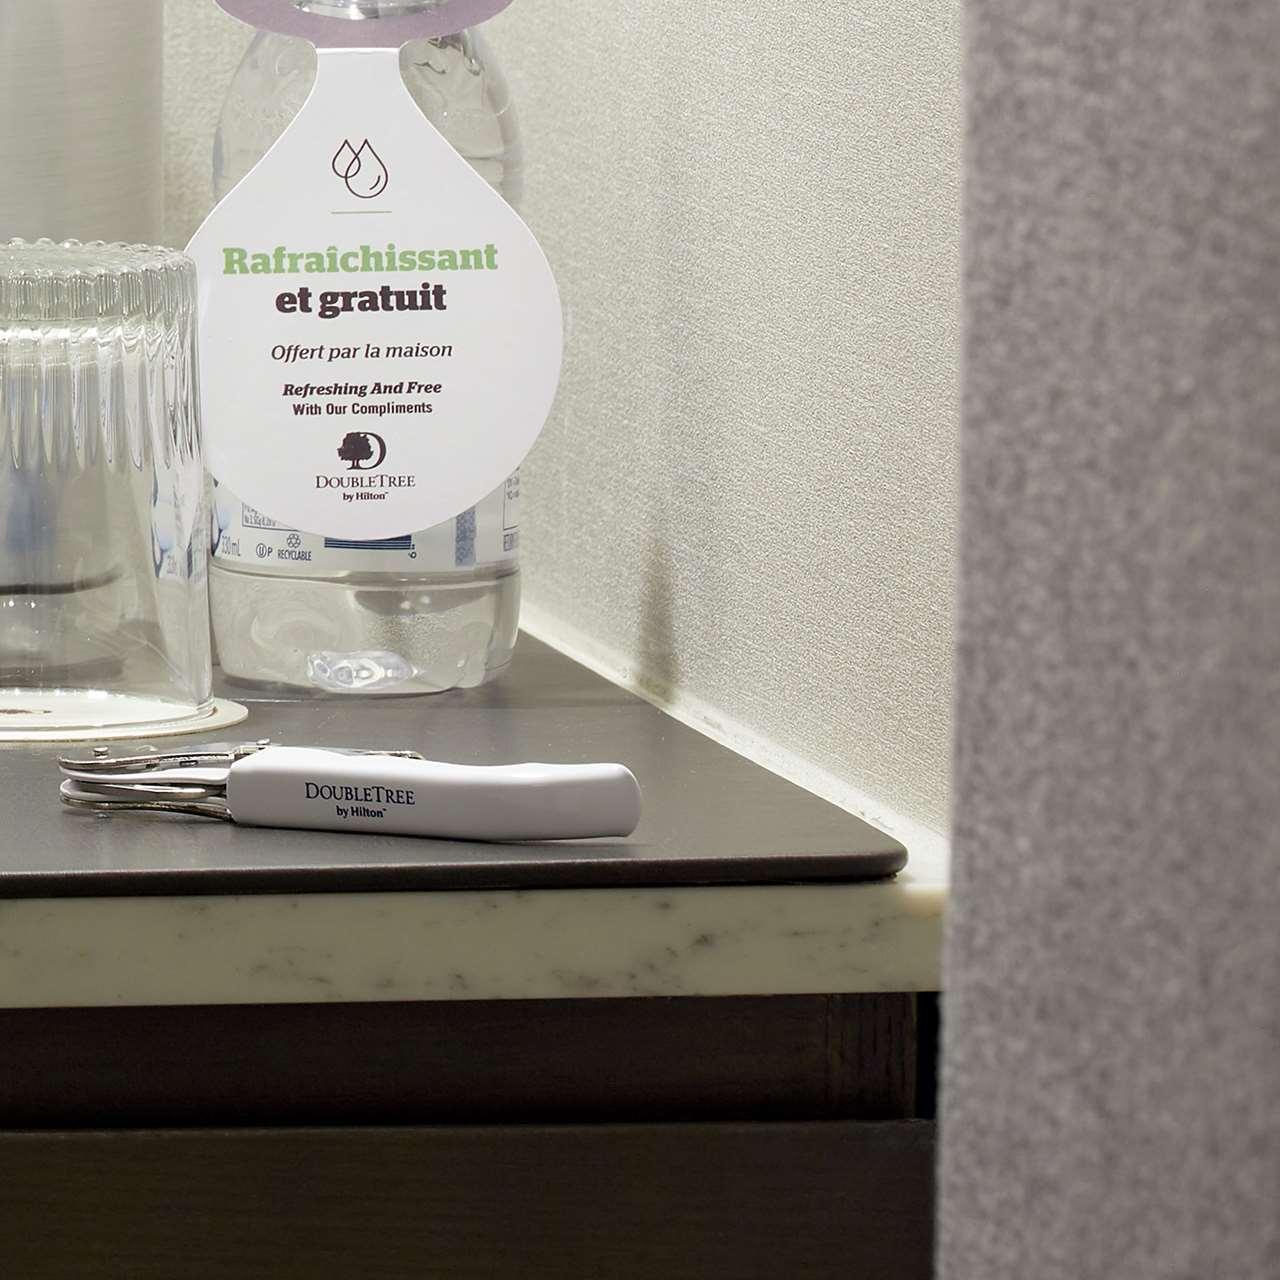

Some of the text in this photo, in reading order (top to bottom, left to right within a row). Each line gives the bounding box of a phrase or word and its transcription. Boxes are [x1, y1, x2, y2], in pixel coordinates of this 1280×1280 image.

[221, 243, 499, 276] Rafraîchissant
[275, 281, 448, 320] et gratuit
[270, 342, 453, 363] Offert par la maison
[282, 380, 443, 399] Refreshing And Free
[292, 401, 433, 417] With Our Compliments
[342, 491, 355, 503] by
[278, 549, 312, 561] RECYCLABLE
[335, 805, 349, 819] by
